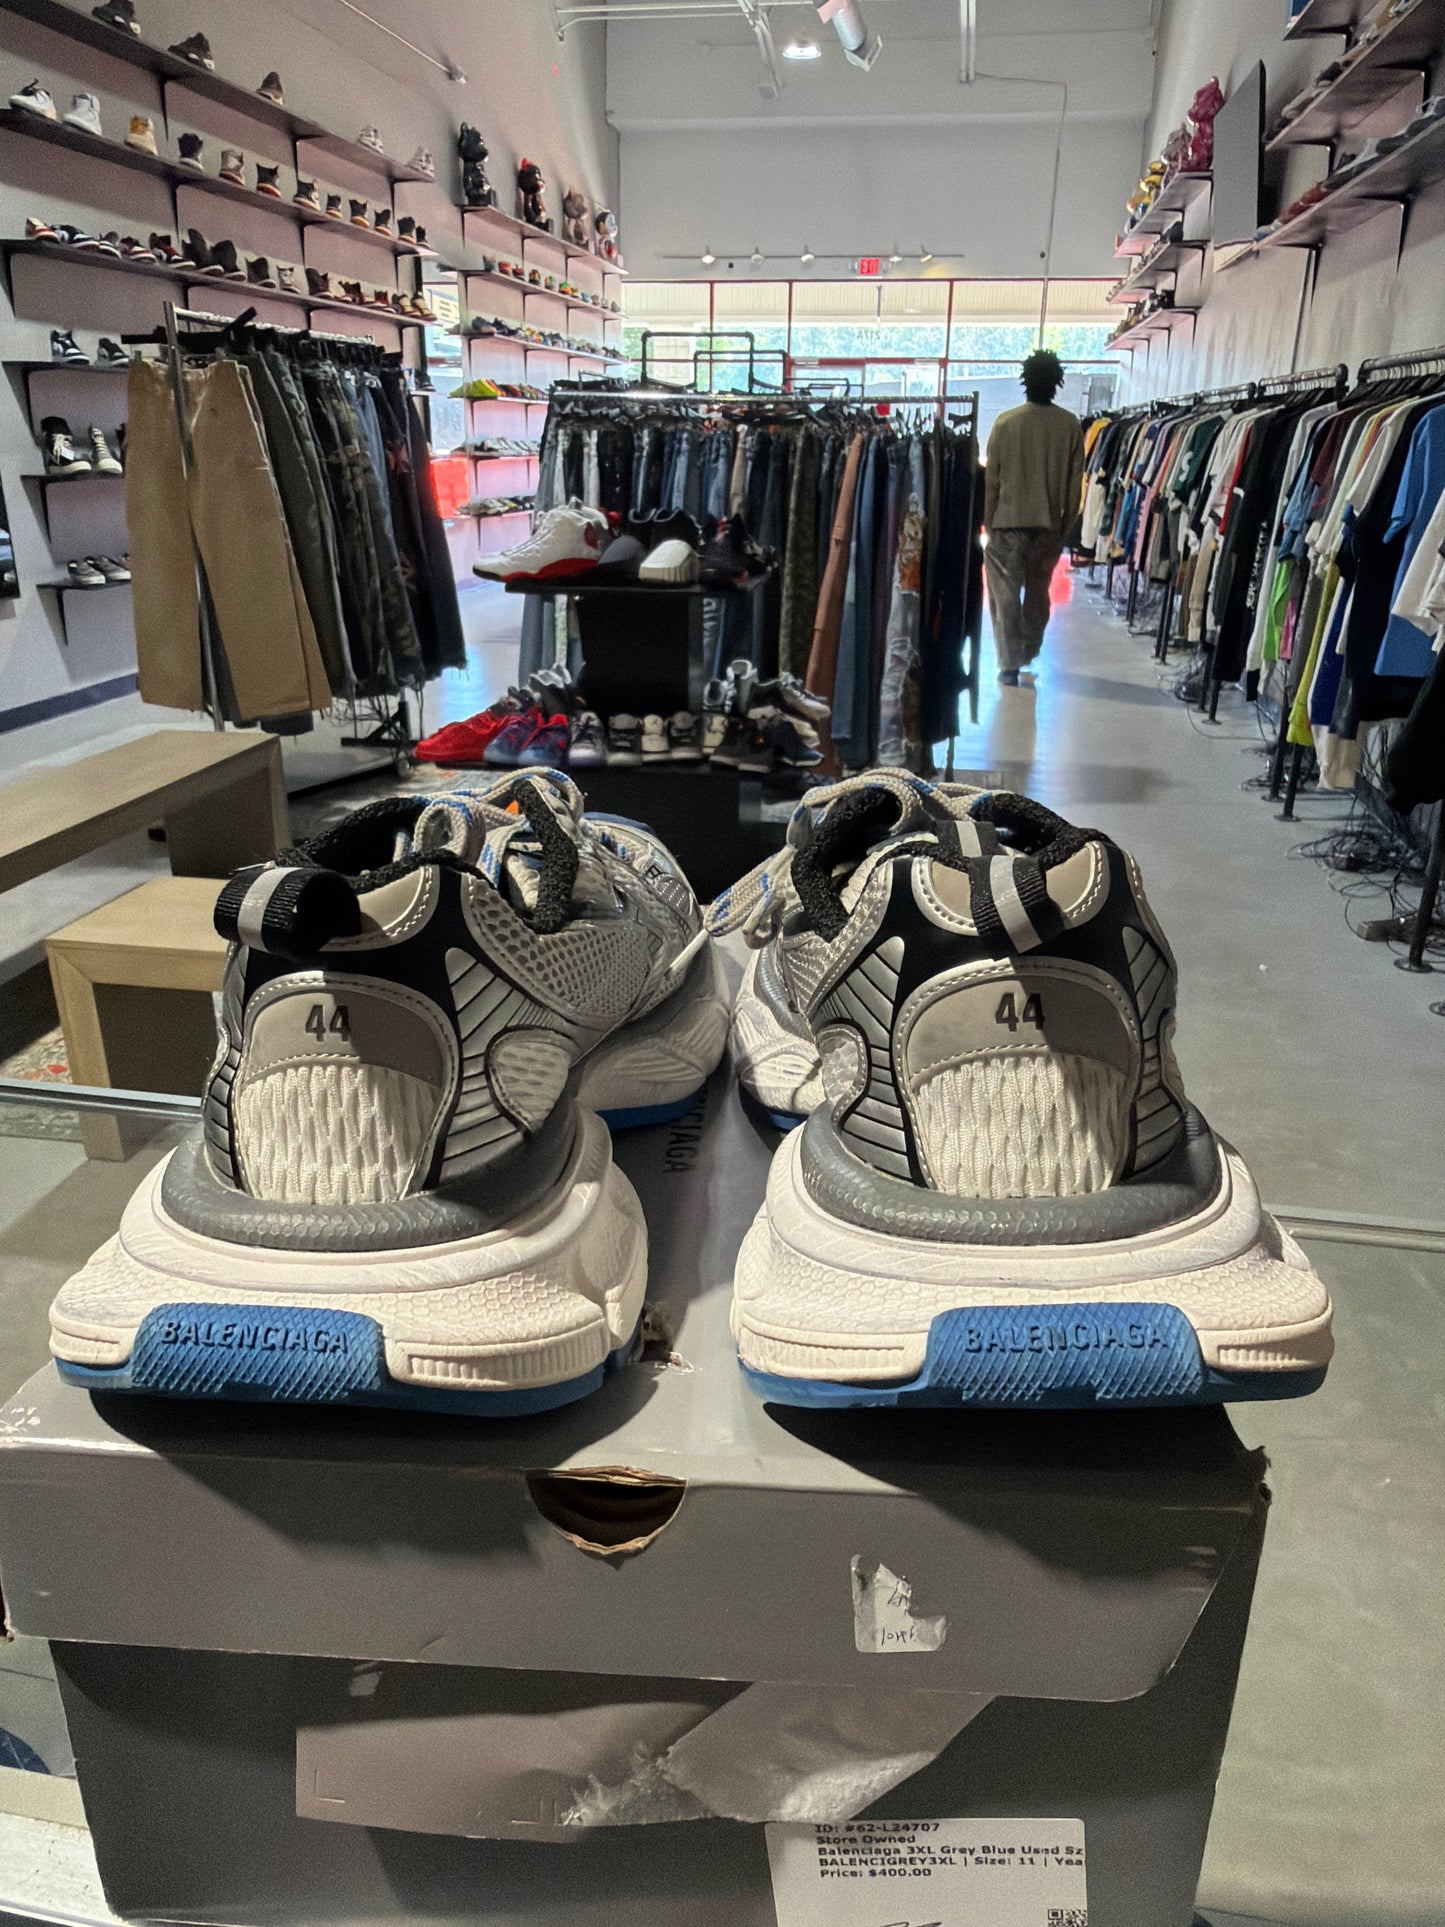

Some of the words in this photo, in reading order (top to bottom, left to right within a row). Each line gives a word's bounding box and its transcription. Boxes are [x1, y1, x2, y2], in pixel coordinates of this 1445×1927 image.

[860, 258, 879, 274] EXIT
[995, 992, 1046, 1032] 44
[305, 1004, 352, 1042] 44
[160, 1321, 349, 1354] BALENCIAGA
[964, 1323, 1169, 1354] BALENCIAGA
[814, 1823, 839, 1834] ID:
[816, 1835, 858, 1845] Store
[861, 1834, 917, 1845] Owned
[818, 1846, 901, 1857] Balenciaga
[906, 1846, 936, 1855] 3XL
[940, 1845, 976, 1856] Grey
[980, 1845, 1016, 1855] Blue
[819, 1856, 958, 1867] BALENCIGREY3XL
[973, 1856, 1012, 1866] Size:
[1018, 1856, 1036, 1866] 11
[819, 1868, 863, 1878] Price:
[868, 1867, 932, 1878] $400.00
